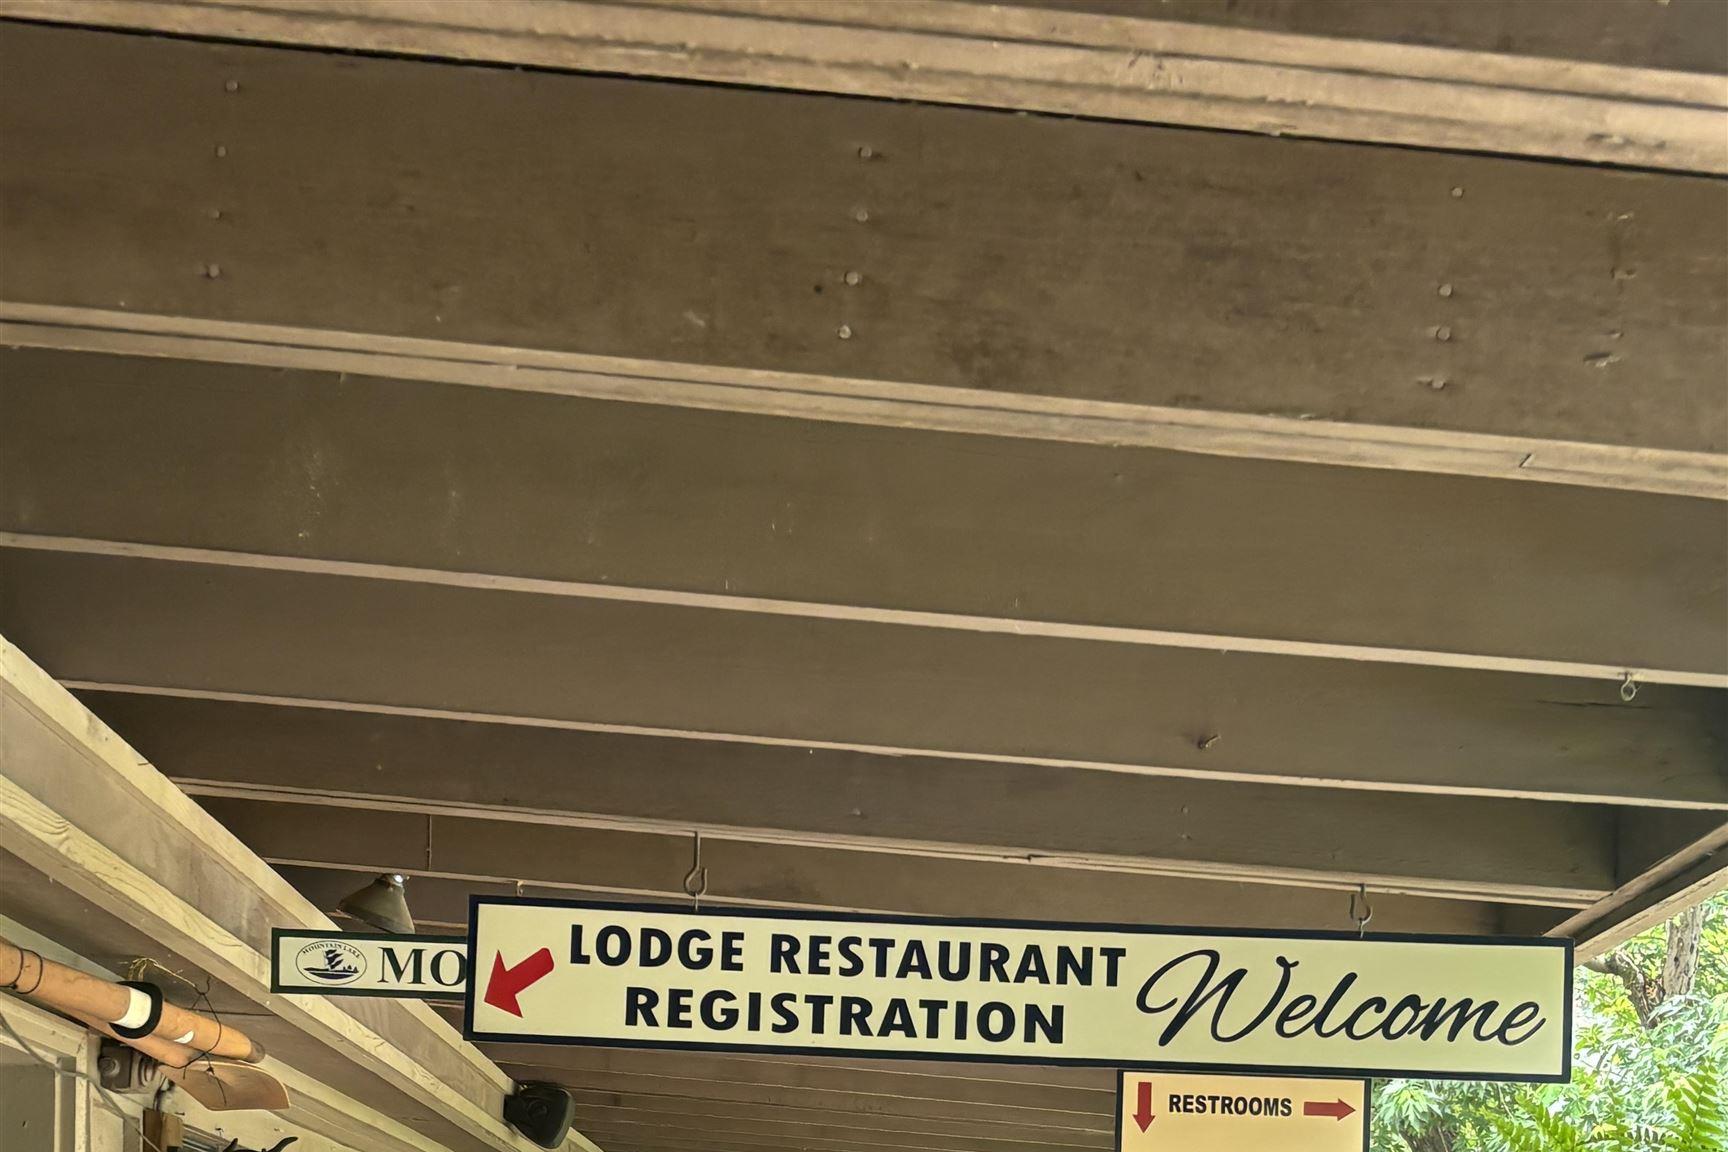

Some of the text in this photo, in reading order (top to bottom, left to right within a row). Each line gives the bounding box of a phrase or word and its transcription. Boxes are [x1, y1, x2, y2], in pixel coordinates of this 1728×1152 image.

[302, 943, 342, 954] MOUNTAIN
[570, 924, 1126, 987] LODGE RESTAURANT
[625, 986, 1065, 1044] REGISTRATION
[1136, 949, 1546, 1047] Welcome
[1168, 1094, 1293, 1117] RESTROOMS
